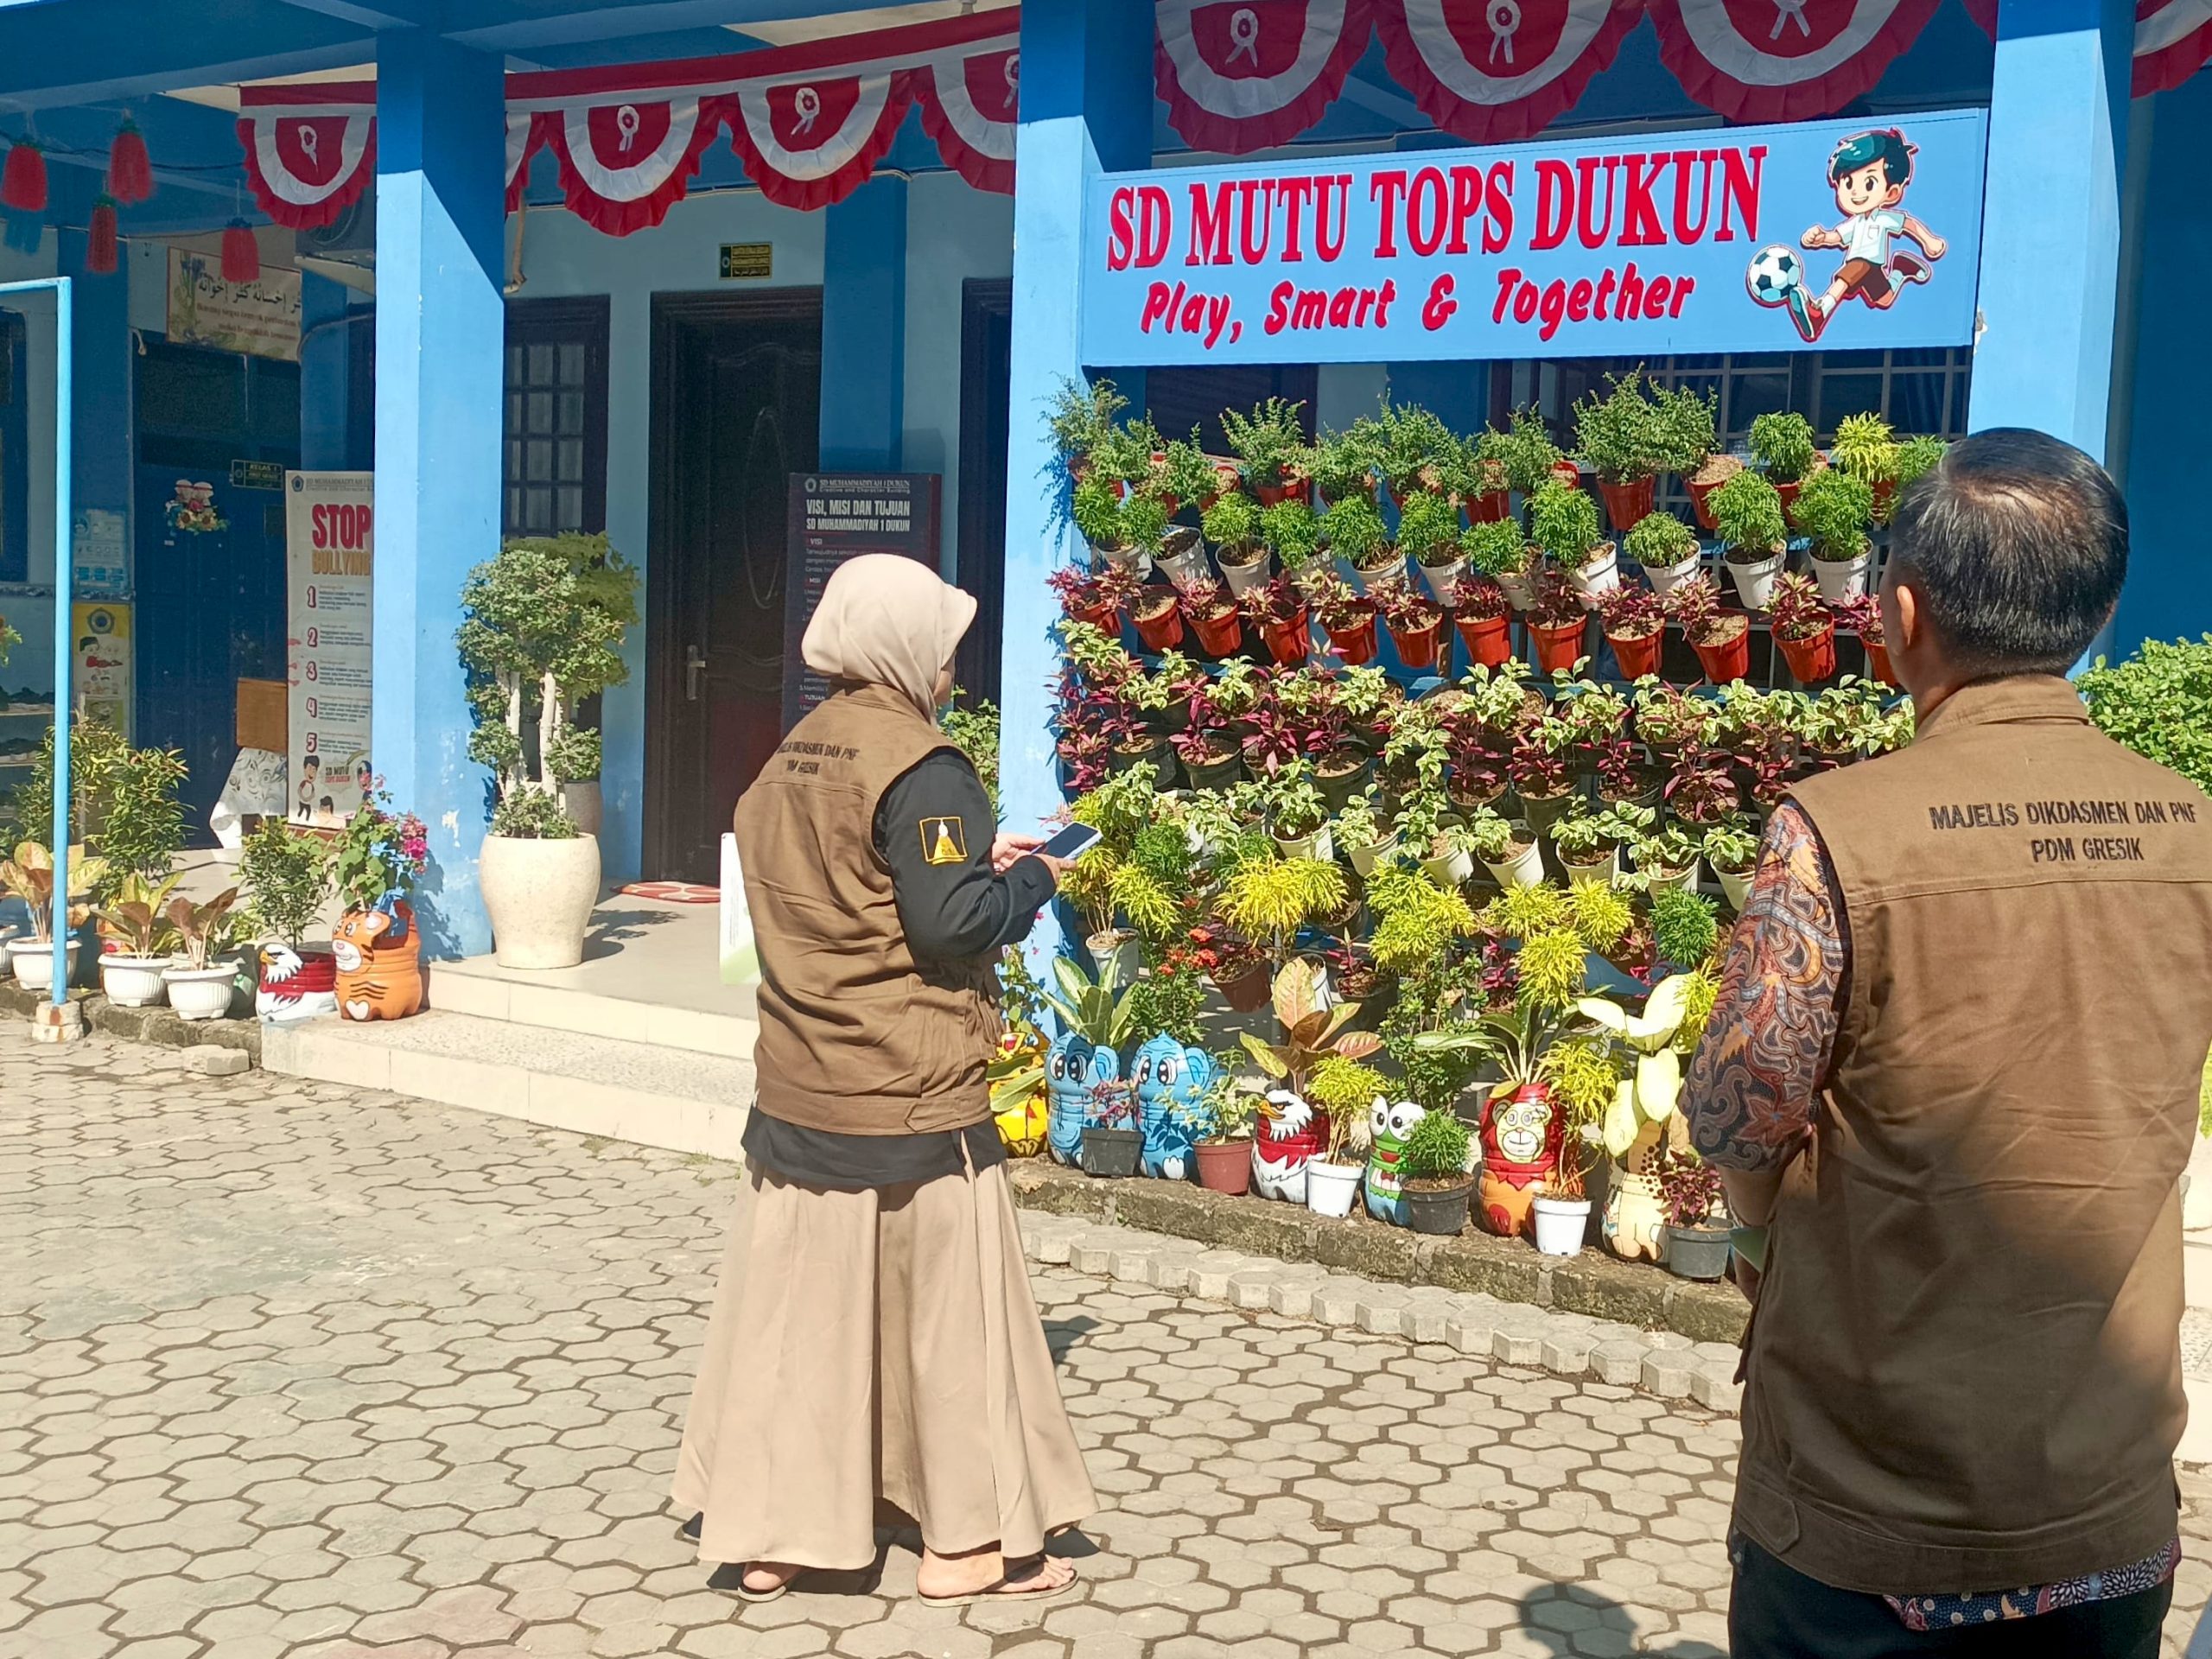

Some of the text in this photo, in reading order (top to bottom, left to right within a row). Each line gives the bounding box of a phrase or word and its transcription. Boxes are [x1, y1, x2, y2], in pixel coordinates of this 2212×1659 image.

[1107, 145, 1768, 271] SD MUTU TOPS DUKUN
[1140, 262, 1695, 350] Play, Smart & Together
[806, 499, 910, 517] VISI, MISI DAN TUJUAN
[312, 503, 372, 550] STOP
[806, 518, 910, 532] SD MUHAMMADIYAH 1 DUKUN
[312, 550, 371, 576] BULLYING
[307, 585, 316, 608] 1
[308, 626, 318, 648] 2
[306, 661, 317, 681] 3
[306, 696, 317, 718] 4
[306, 732, 317, 753] 5
[1929, 800, 2197, 830] MAJELIS DIKDASMEN DAN PNF
[2031, 837, 2145, 863] PDM GRESIK
